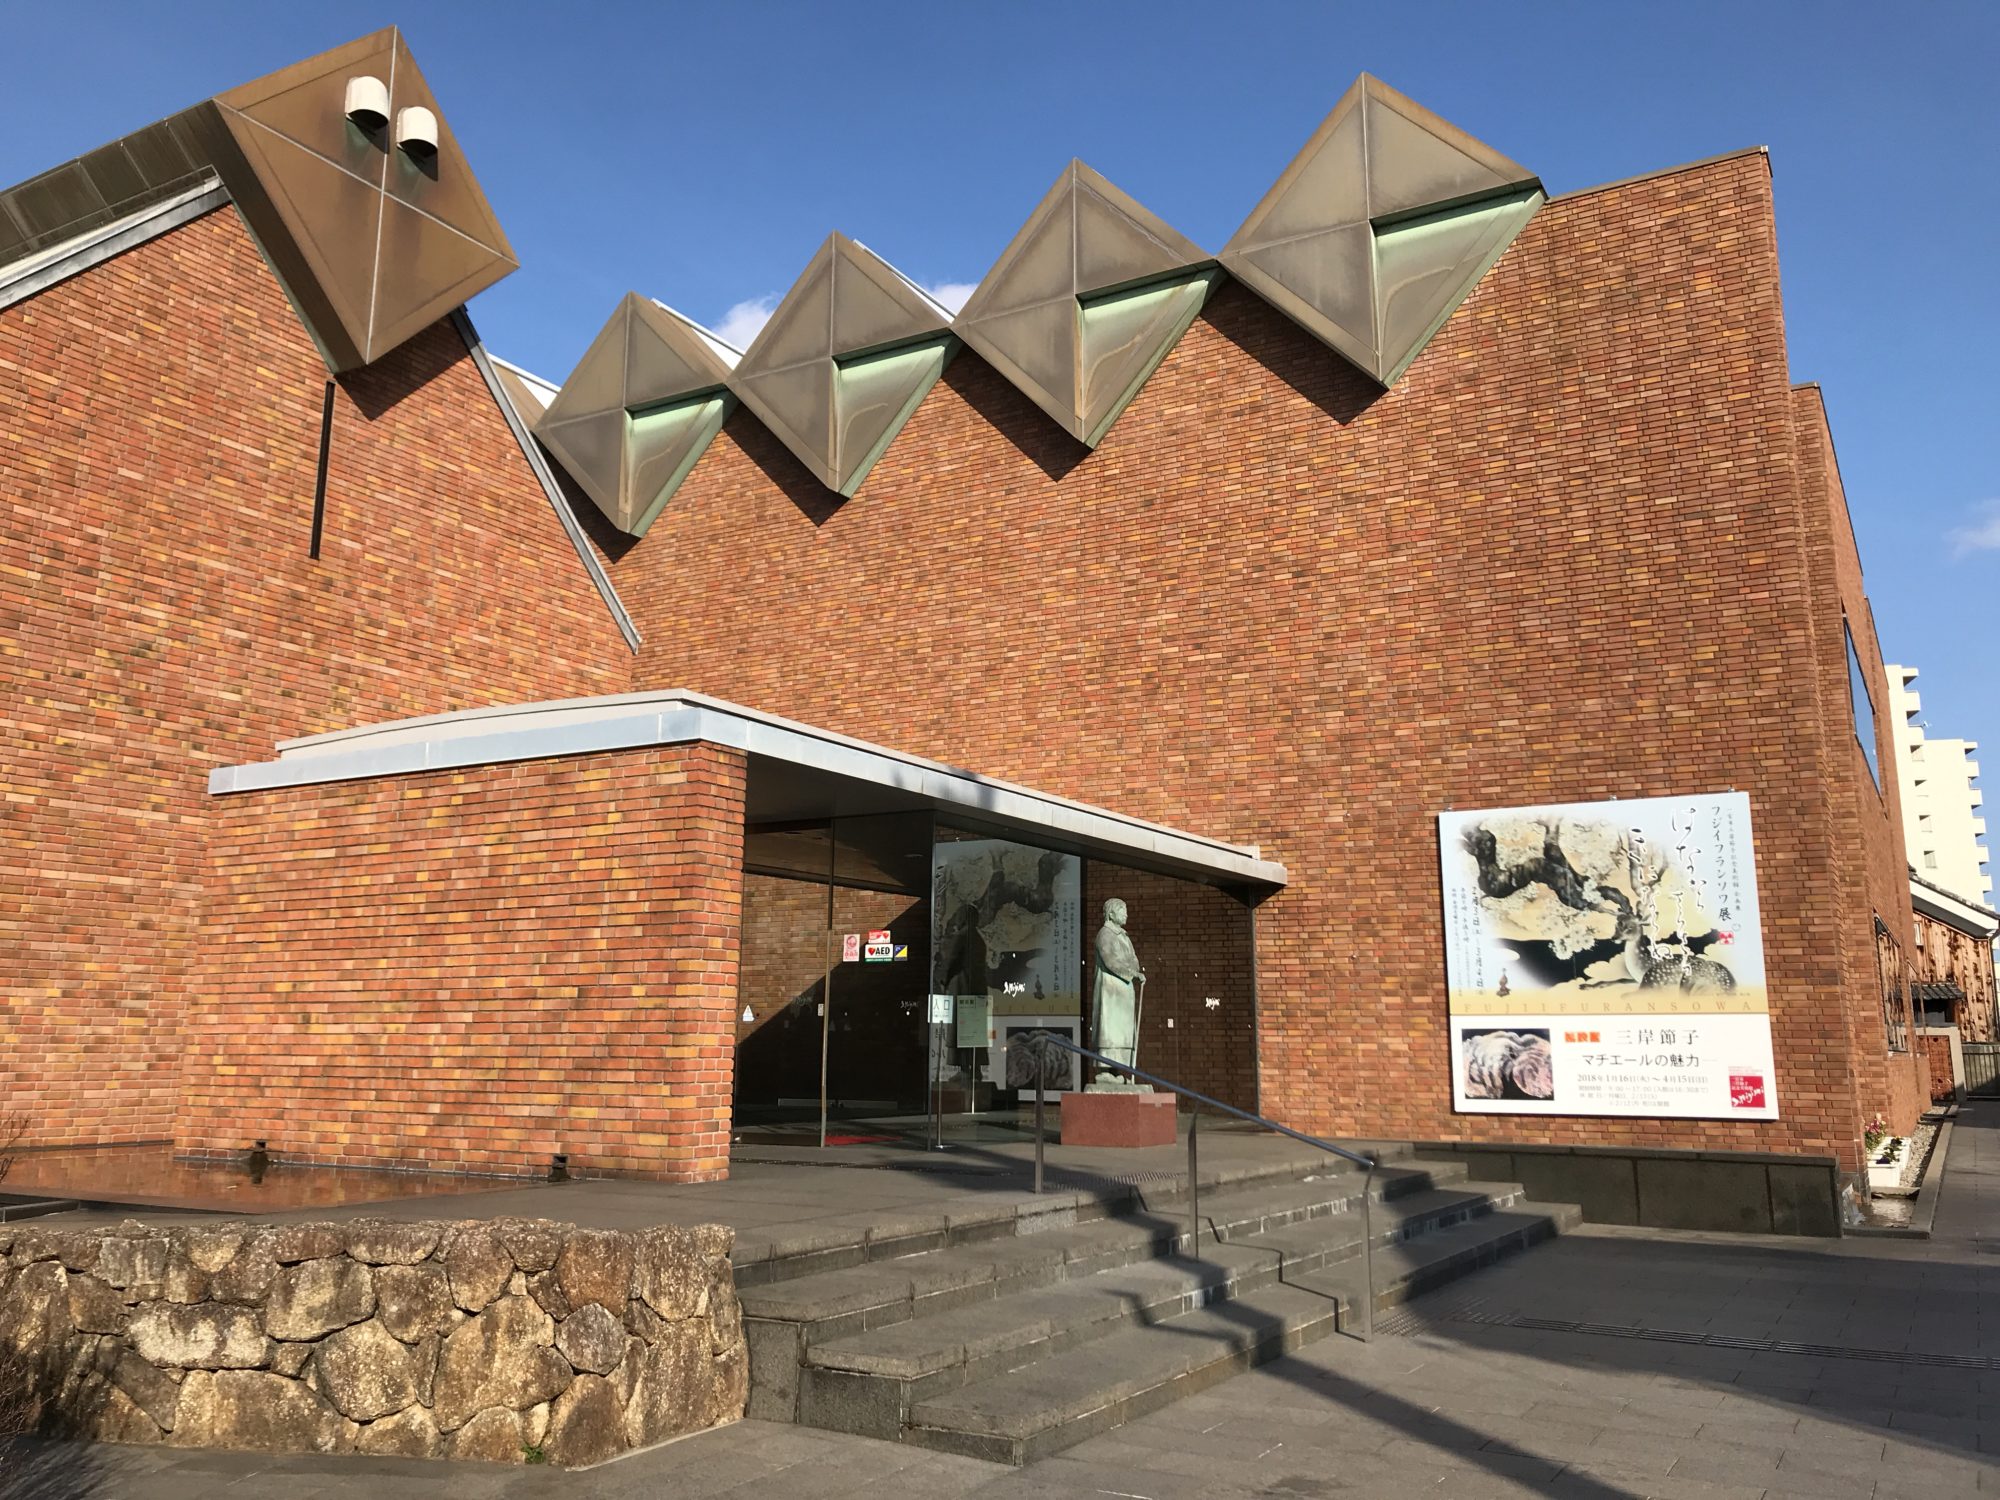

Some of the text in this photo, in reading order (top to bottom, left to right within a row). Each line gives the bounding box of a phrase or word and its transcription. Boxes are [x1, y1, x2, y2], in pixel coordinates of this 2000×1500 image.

[1711, 805, 1732, 921] フジイフランソワ展
[875, 946, 891, 955] AED
[933, 999, 950, 1011] 入口
[1616, 1029, 1700, 1046] 三岸節子
[1582, 1054, 1700, 1068] マチエールの魅力
